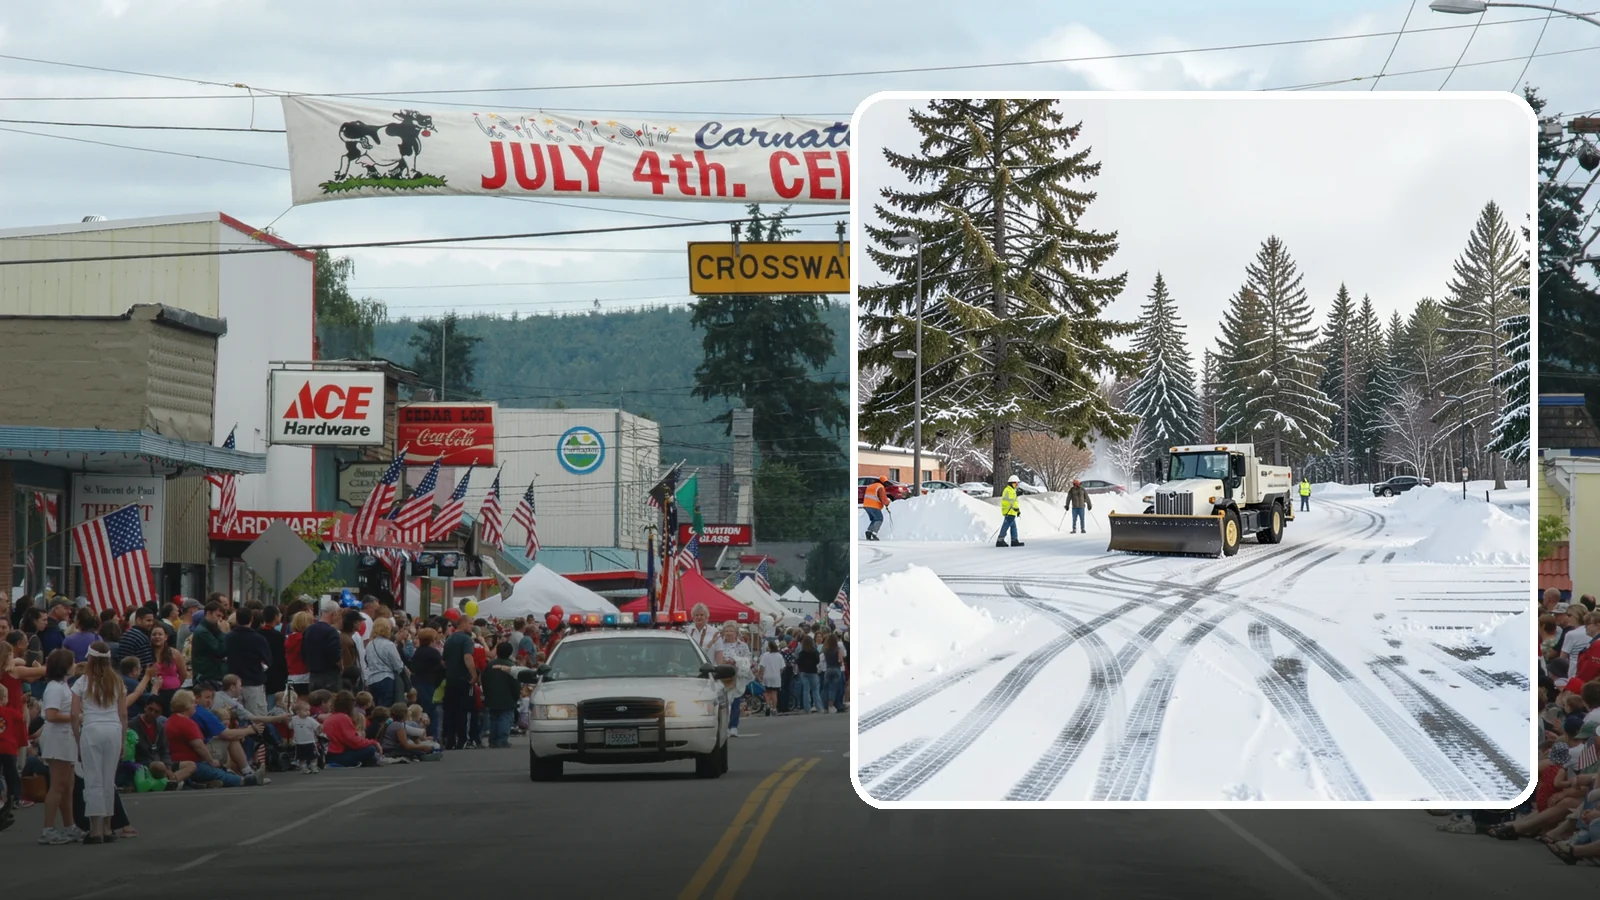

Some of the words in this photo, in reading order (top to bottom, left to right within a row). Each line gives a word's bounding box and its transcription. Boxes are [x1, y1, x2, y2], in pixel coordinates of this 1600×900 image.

[481, 141, 604, 192] JULY
[632, 150, 746, 198] 4th.
[696, 253, 850, 280] CROSSWA
[283, 380, 373, 419] ACE
[405, 409, 452, 422] CEDAR
[283, 421, 371, 436] Hardware
[416, 428, 477, 447] Coca-Cola
[353, 467, 386, 479] Simpl
[83, 485, 93, 494] St.
[96, 485, 124, 495] Vincent
[126, 486, 135, 494] de
[137, 486, 155, 495] Paul
[688, 526, 741, 535] CRNATION
[699, 535, 730, 543] GLASS
